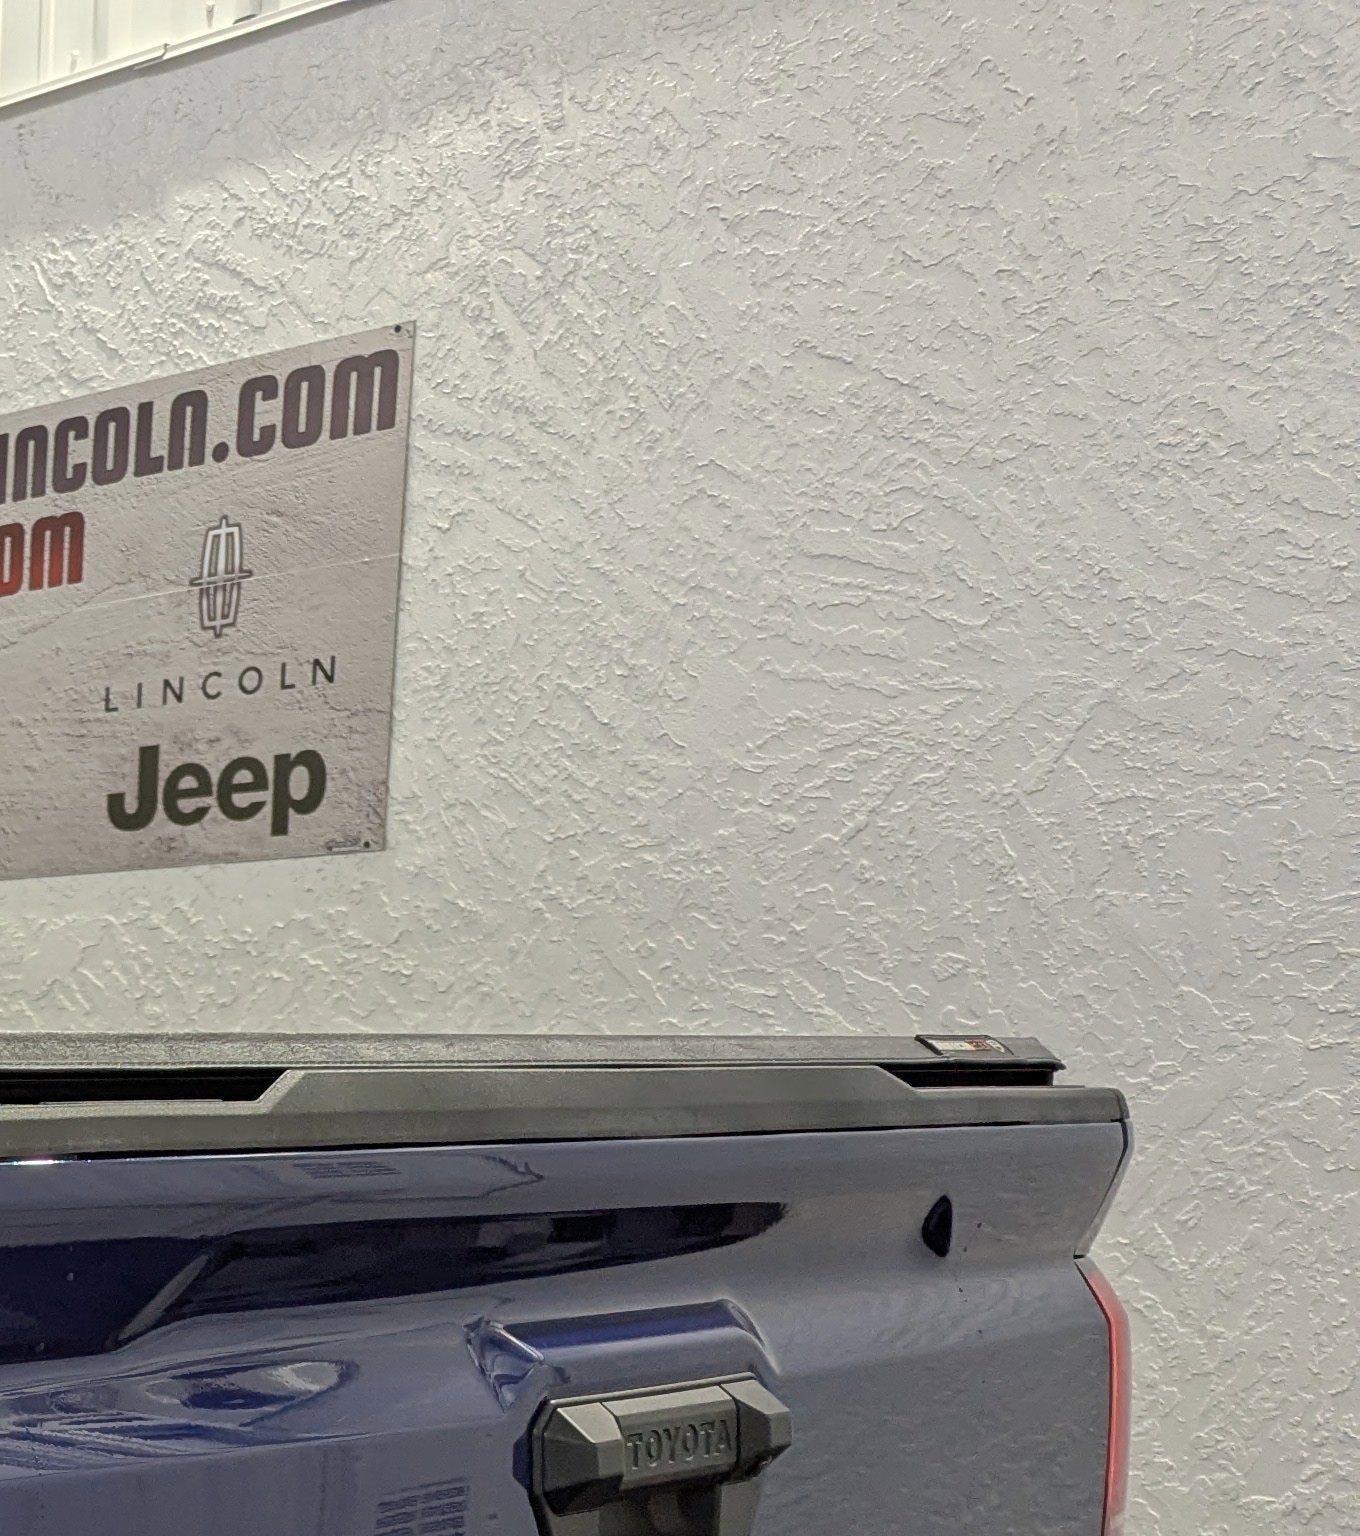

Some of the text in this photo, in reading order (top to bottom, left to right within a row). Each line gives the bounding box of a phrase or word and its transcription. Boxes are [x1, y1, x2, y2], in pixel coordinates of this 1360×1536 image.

[103, 654, 337, 714] LINCOLN
[107, 742, 328, 835] Jeep
[626, 1418, 732, 1470] TOYOTA
